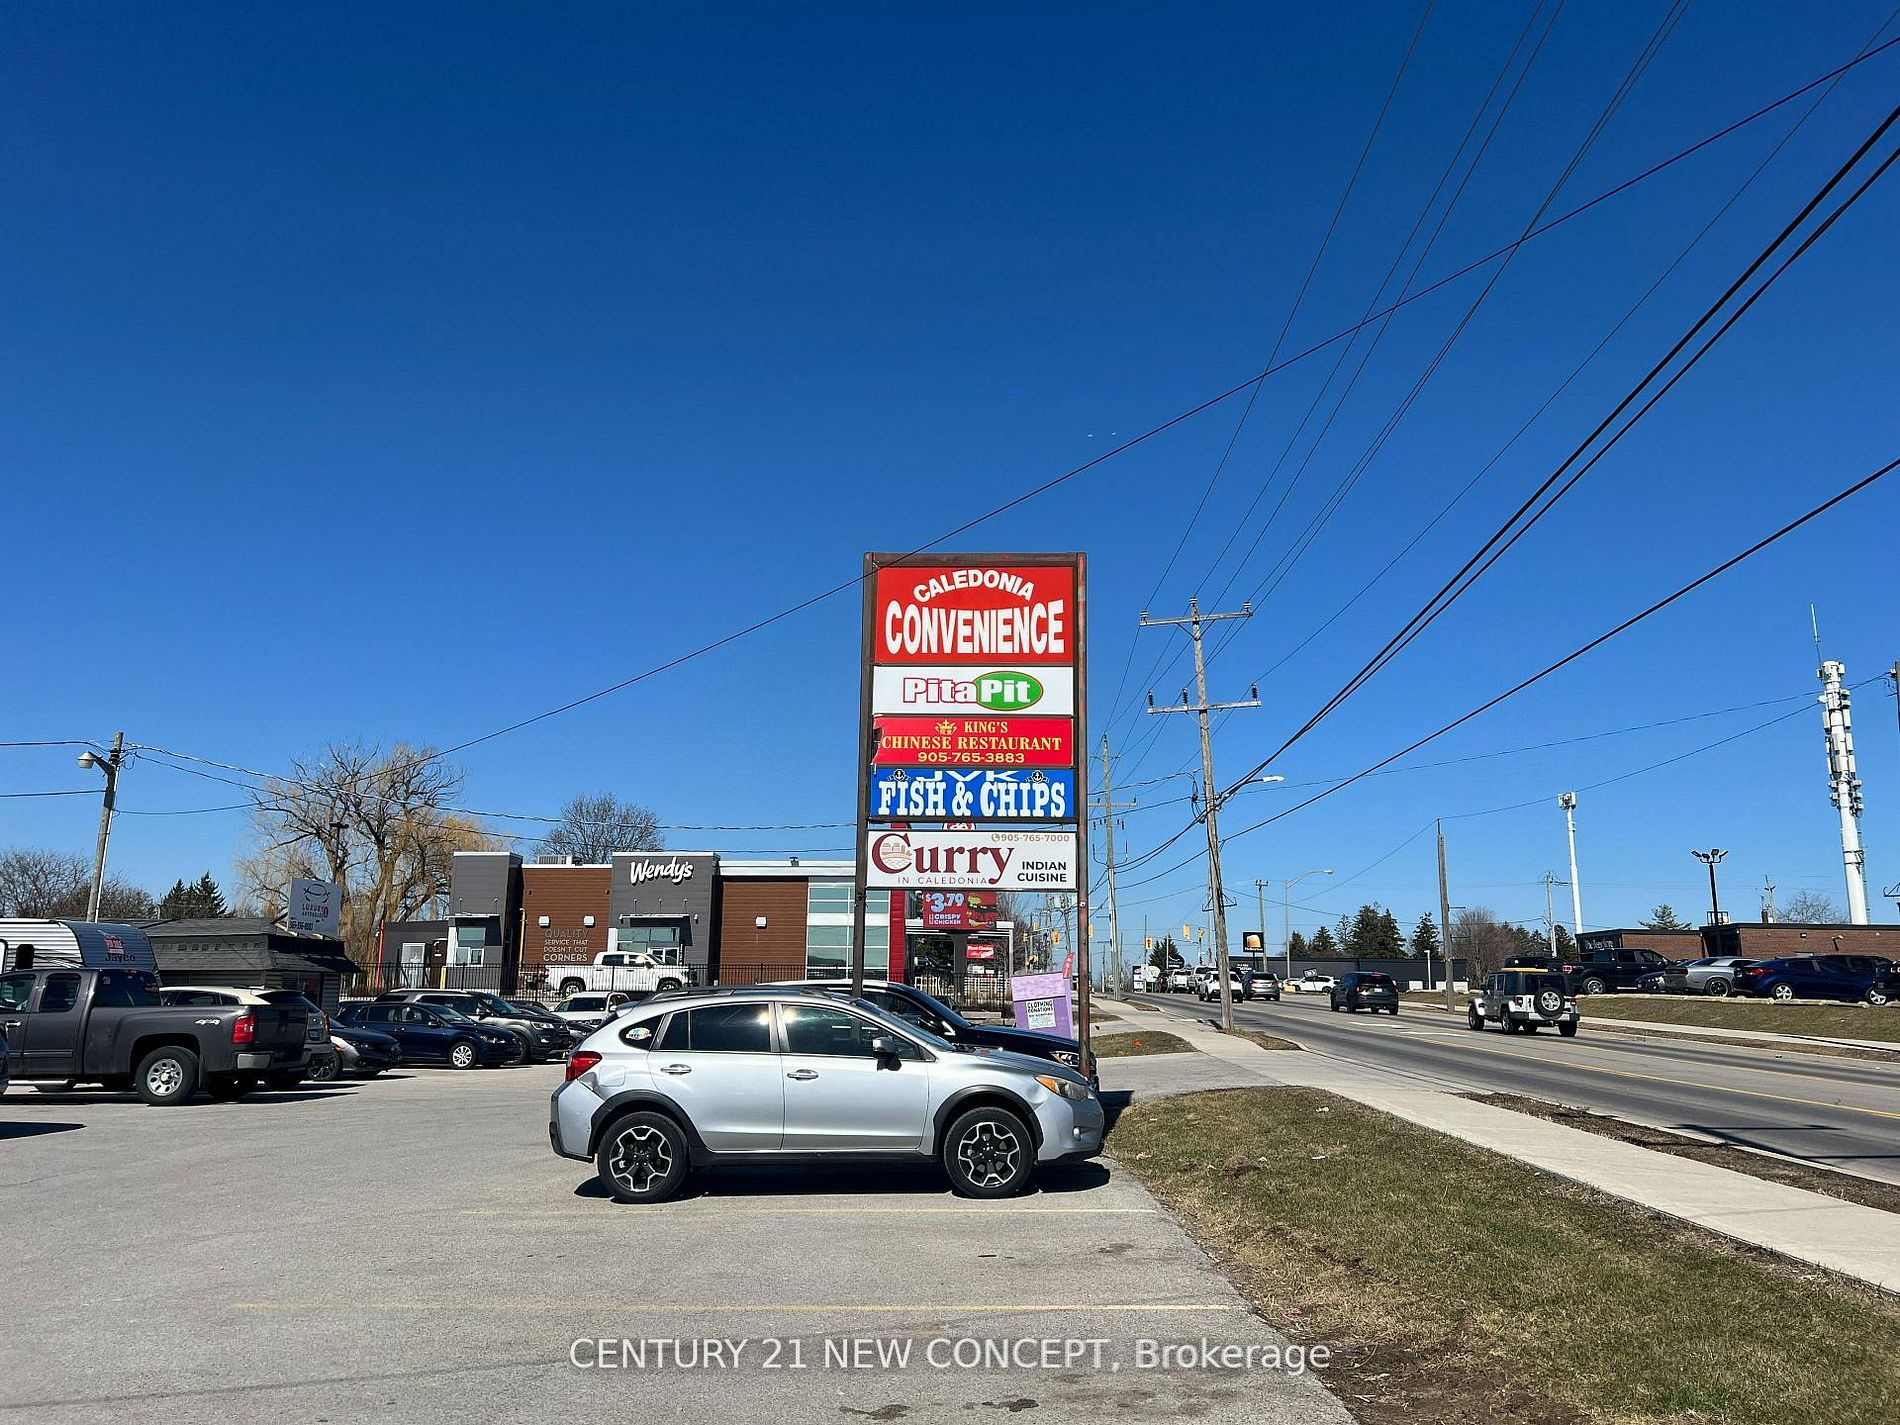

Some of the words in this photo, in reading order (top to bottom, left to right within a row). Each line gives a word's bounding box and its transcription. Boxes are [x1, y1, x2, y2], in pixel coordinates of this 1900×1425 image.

[913, 569, 1035, 602] CALEDONIA
[885, 599, 1065, 655] CONVENIENCE
[964, 721, 1009, 733] KING'S
[882, 736, 952, 749] CHINESE
[957, 737, 1062, 751] RESTAURANT
[917, 752, 1025, 763] 905-765-3883
[878, 780, 946, 816] FISH
[951, 780, 974, 817] &
[980, 780, 1066, 818] CHIPS
[1000, 833, 1070, 842] 905-765-7000
[871, 832, 1015, 885] Curry
[630, 857, 694, 884] Wendy's
[1021, 861, 1067, 871] INDIAN
[897, 876, 910, 885] IN
[917, 876, 988, 885] CALEDONIA
[1017, 873, 1067, 883] CUISINE
[544, 929, 590, 938] QUALITY
[104, 952, 136, 964] Jayco
[543, 953, 588, 962] CORNERS
